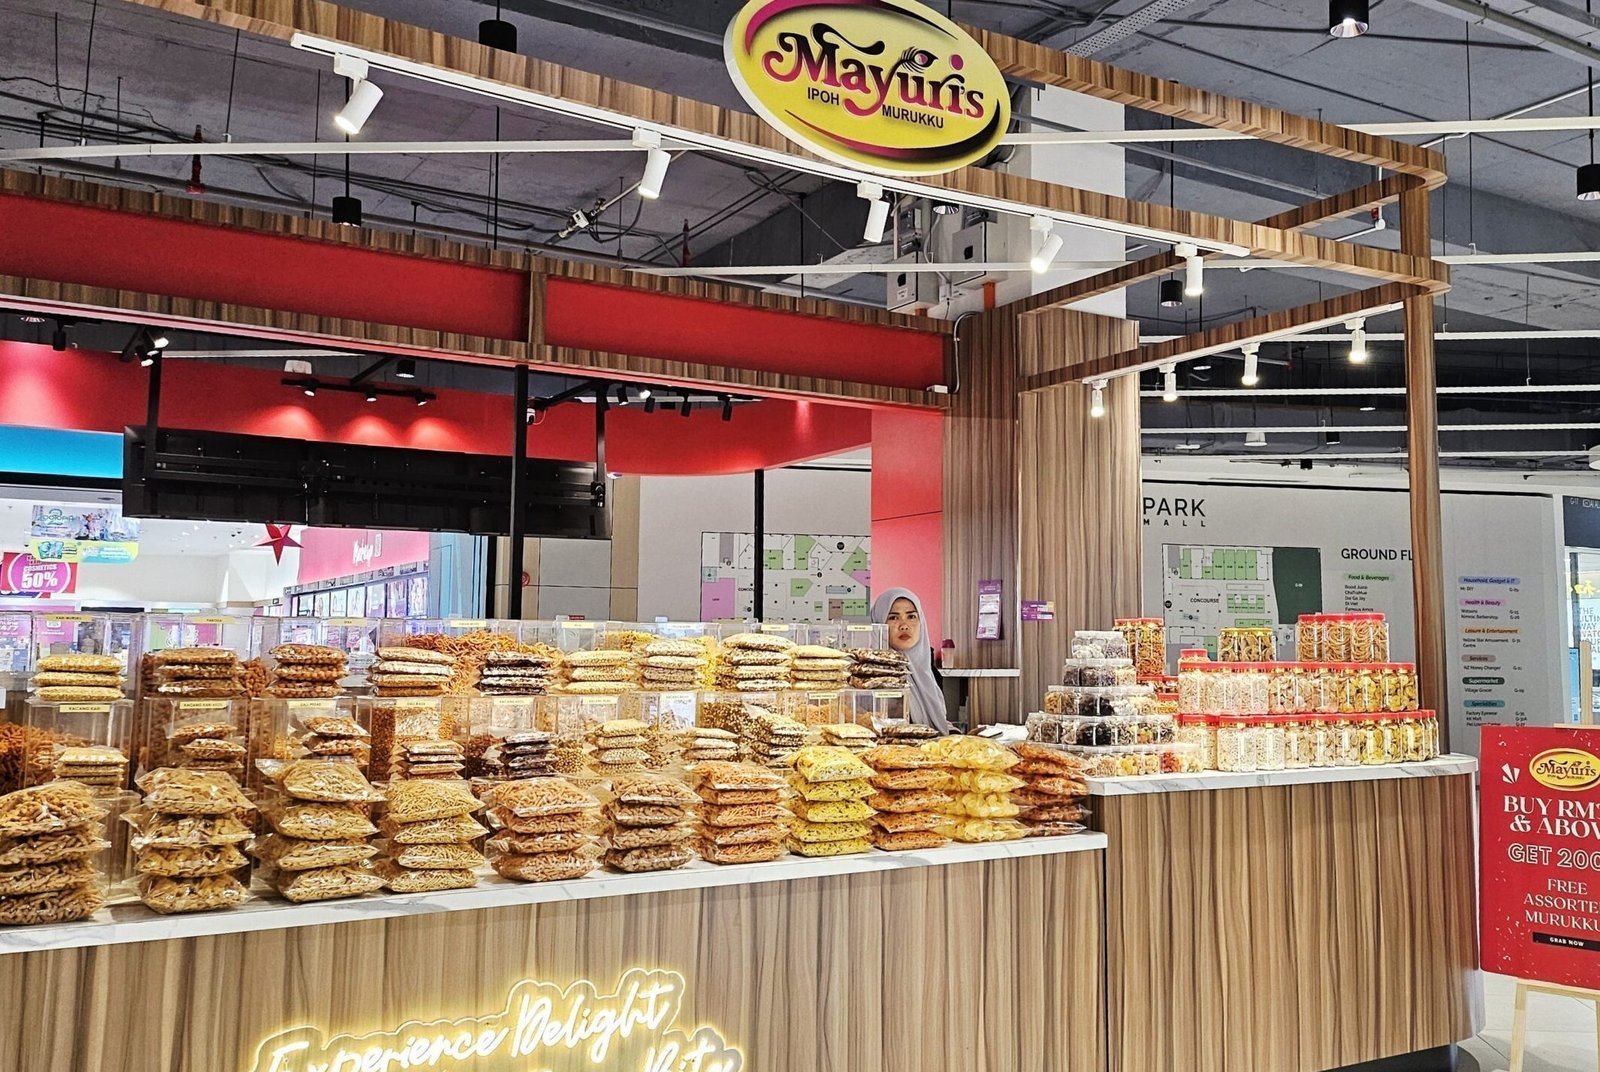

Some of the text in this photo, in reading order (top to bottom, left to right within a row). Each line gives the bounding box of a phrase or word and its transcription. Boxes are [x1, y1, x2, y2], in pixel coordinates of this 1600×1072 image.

[807, 87, 944, 129] IPOH MURUKKU
[1143, 497, 1206, 517] PARK
[1341, 548, 1397, 560] GROUND
[21, 571, 58, 589] 50%
[1504, 795, 1552, 816] BUY
[1509, 814, 1532, 832] &
[1507, 842, 1552, 866] GET
[1548, 878, 1588, 895] FREE
[1525, 909, 1600, 933] MURUKKU
[1568, 939, 1584, 947] NOW
[510, 981, 675, 1064] Delight
